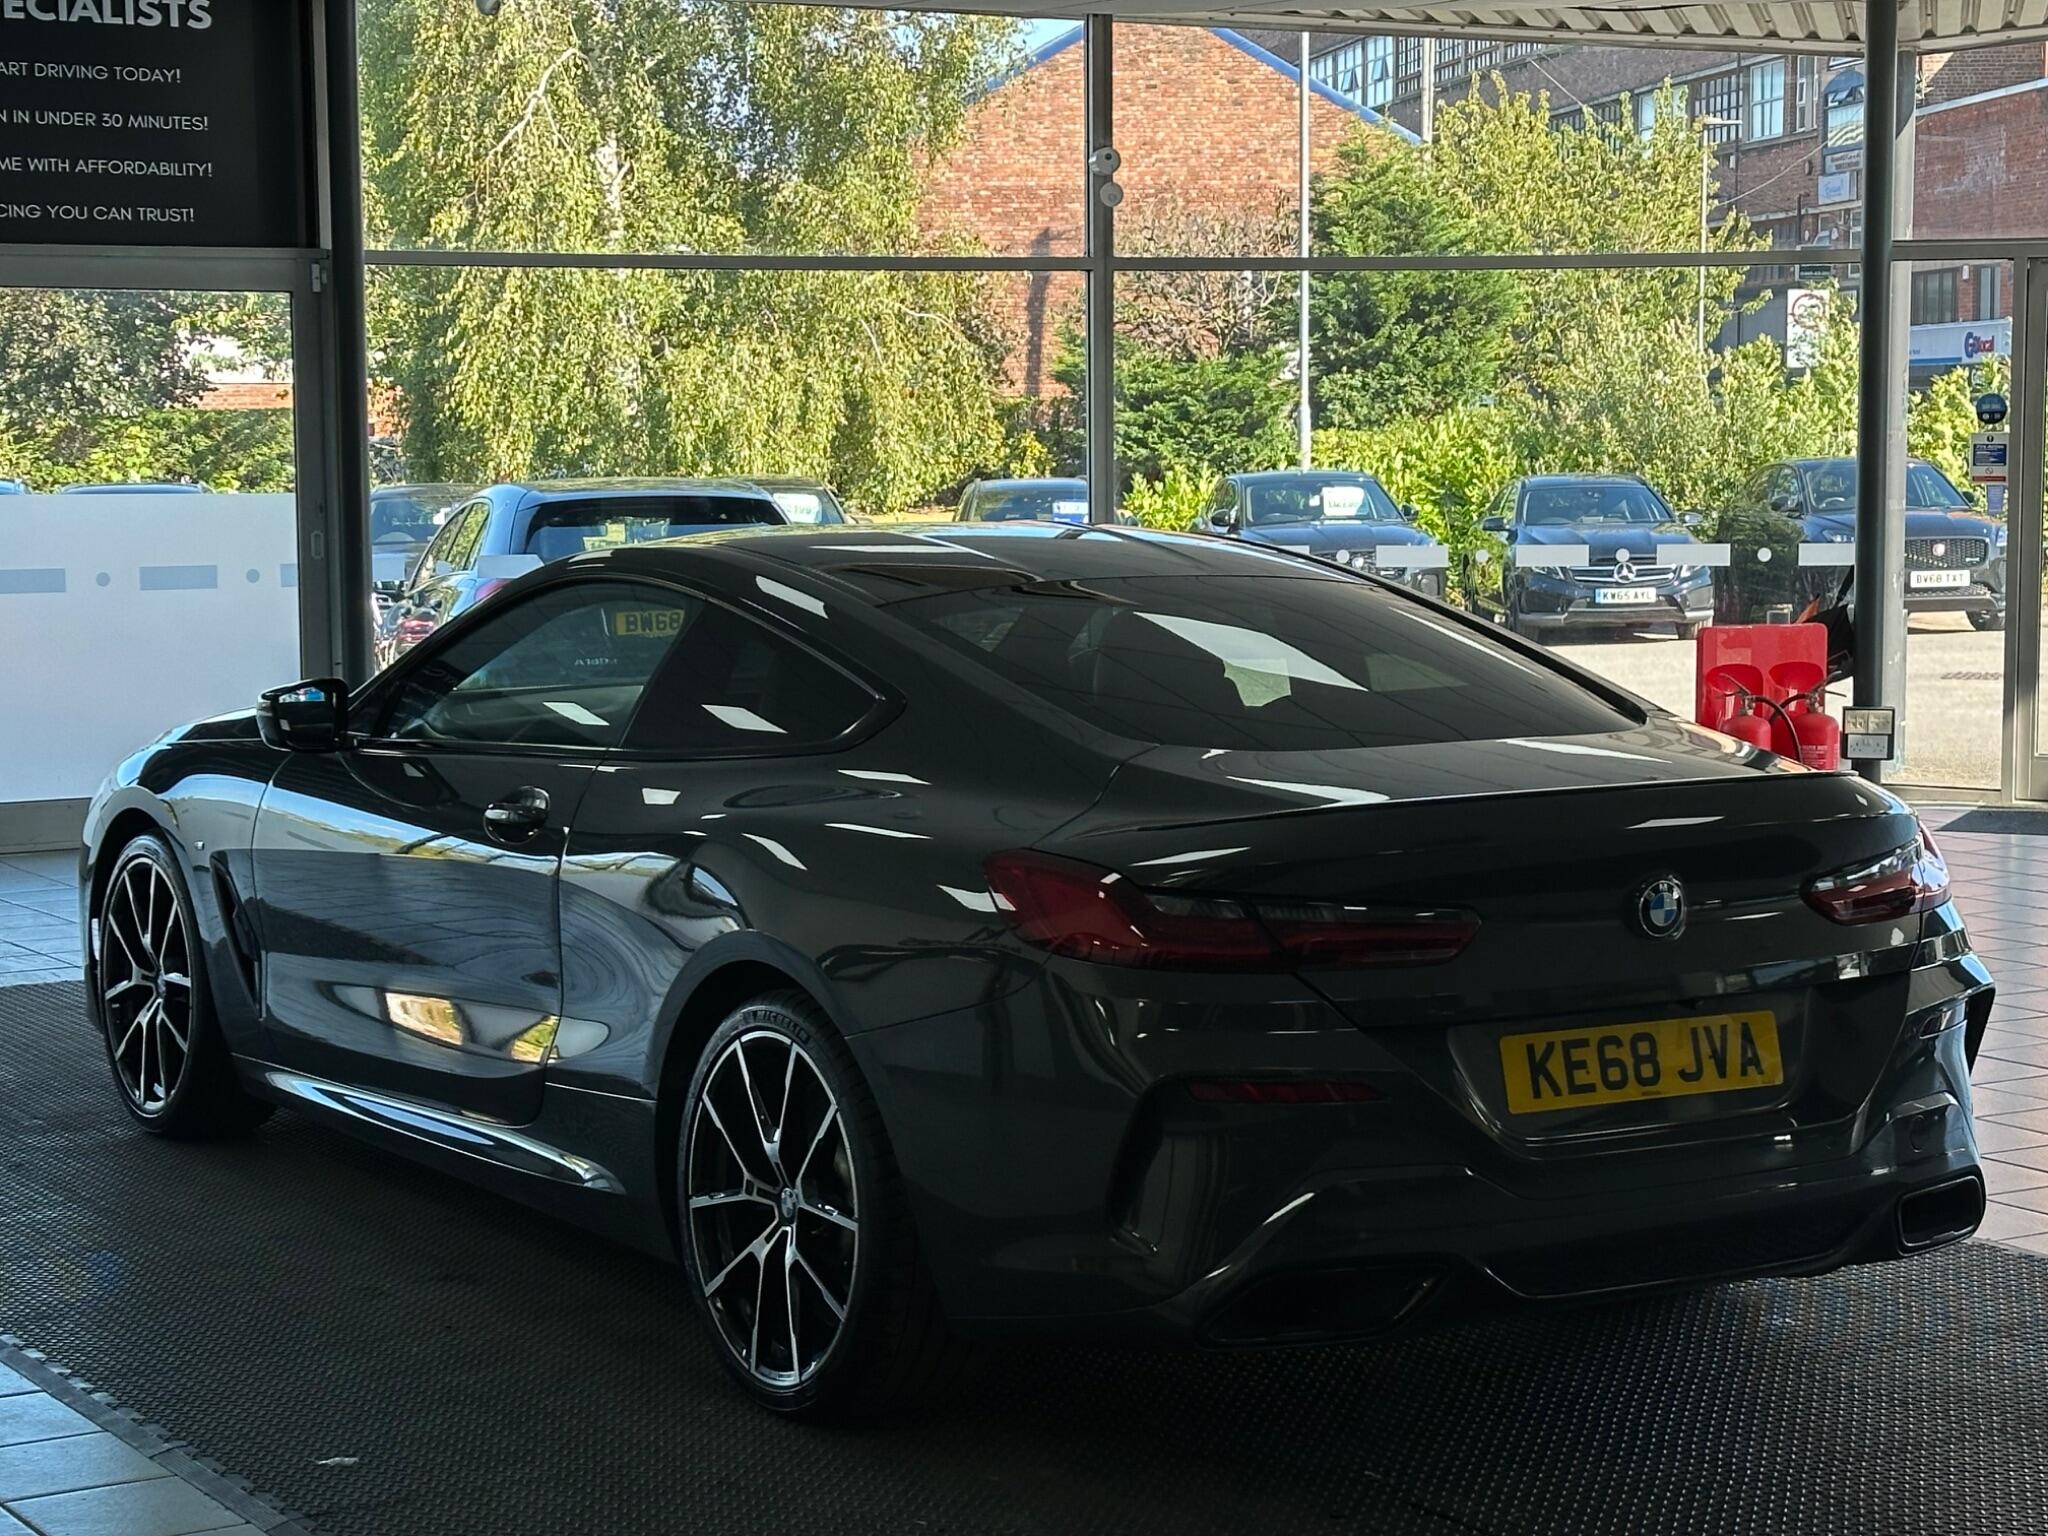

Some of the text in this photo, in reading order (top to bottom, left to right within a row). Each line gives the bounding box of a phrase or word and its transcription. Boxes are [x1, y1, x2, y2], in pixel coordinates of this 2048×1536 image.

[3, 0, 213, 30] ECIALISTS
[0, 62, 181, 84] ART DRIVING TODAY!
[13, 109, 30, 124] IN
[35, 110, 96, 127] UNDER
[101, 113, 123, 128] 30
[128, 115, 208, 131] MINUTES!
[0, 157, 213, 177] ME WITH AFFORDABILITY!
[46, 205, 88, 220] YOU
[93, 206, 132, 221] CAN
[137, 207, 195, 222] TRUST!
[625, 611, 681, 633] BW68
[1525, 1022, 1764, 1099] KE68 JVA
